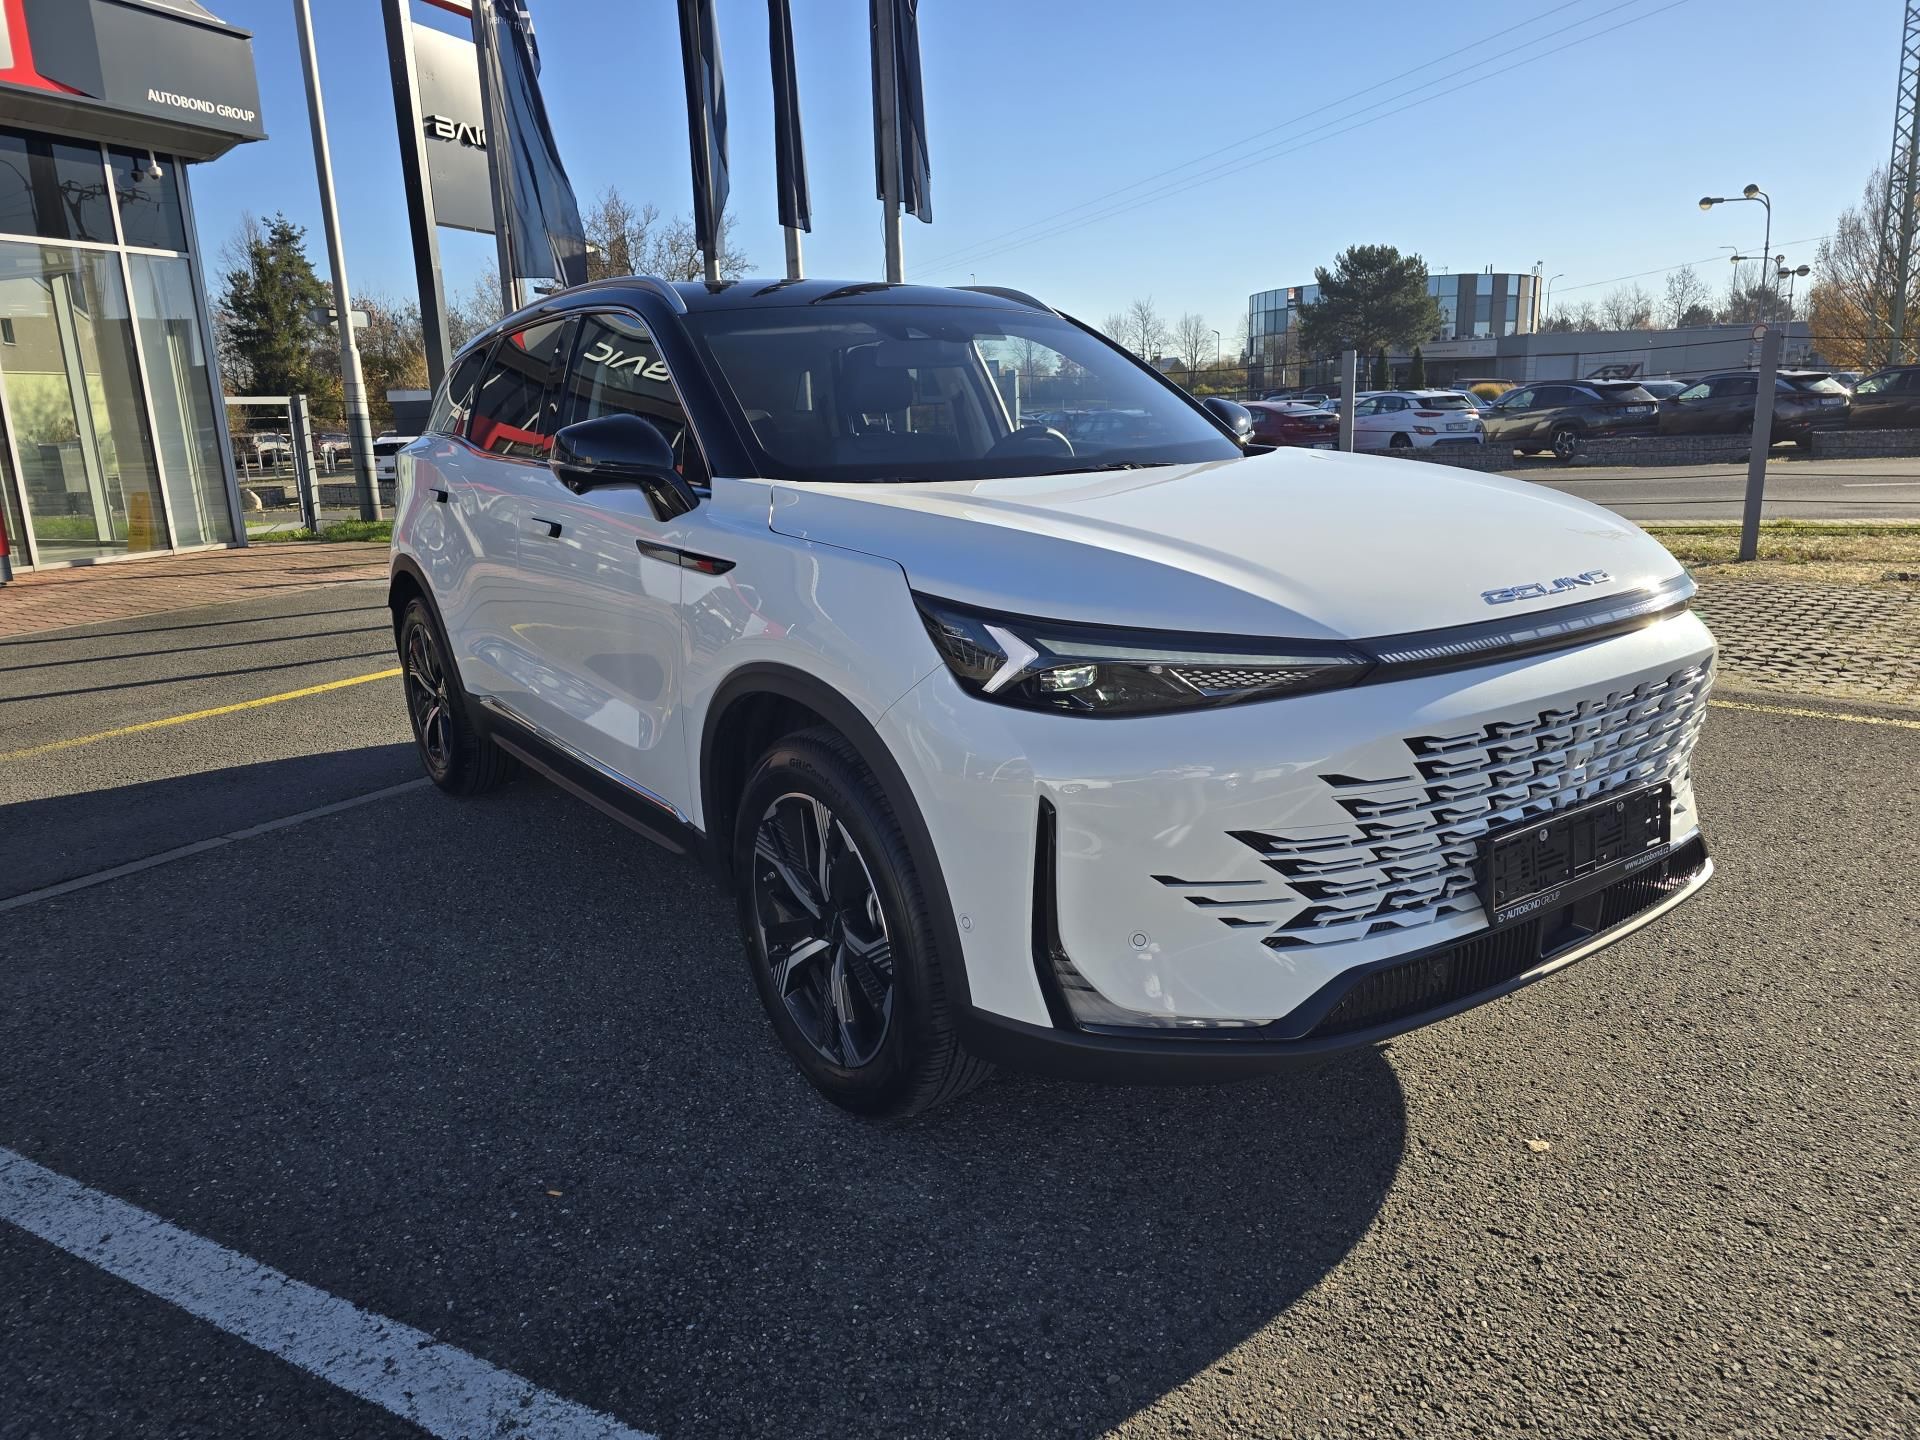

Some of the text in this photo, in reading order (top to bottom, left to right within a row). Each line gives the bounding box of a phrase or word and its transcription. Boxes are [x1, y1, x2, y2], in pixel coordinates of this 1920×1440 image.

[147, 88, 255, 122] AUTOBOND GROUP
[433, 115, 486, 146] BAI
[1506, 899, 1541, 920] AUTOBOND
